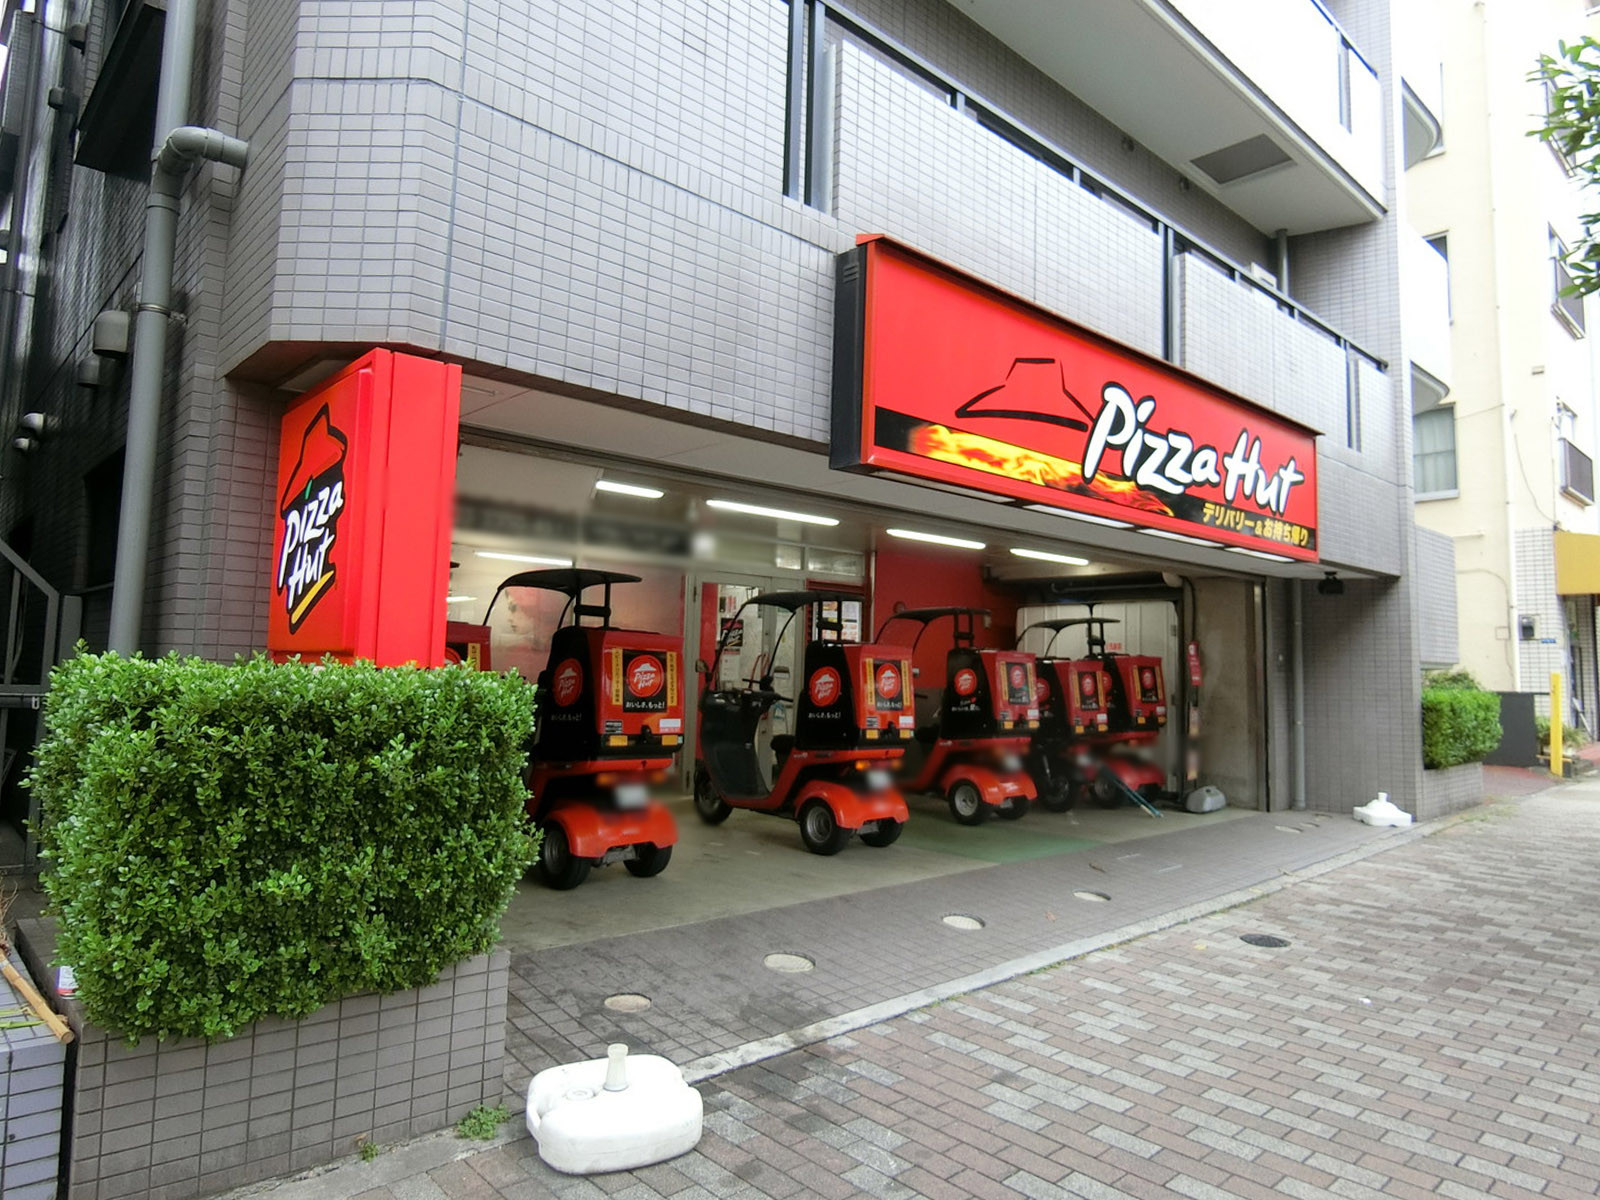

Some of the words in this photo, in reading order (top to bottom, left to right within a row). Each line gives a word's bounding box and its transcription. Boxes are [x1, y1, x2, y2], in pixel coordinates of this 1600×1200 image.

[1083, 385, 1221, 495] Pizza
[1222, 430, 1305, 515] Hut
[278, 480, 344, 589] Pizza
[287, 527, 335, 610] Hut
[633, 671, 656, 683] Pizza
[637, 679, 654, 690] Hut
